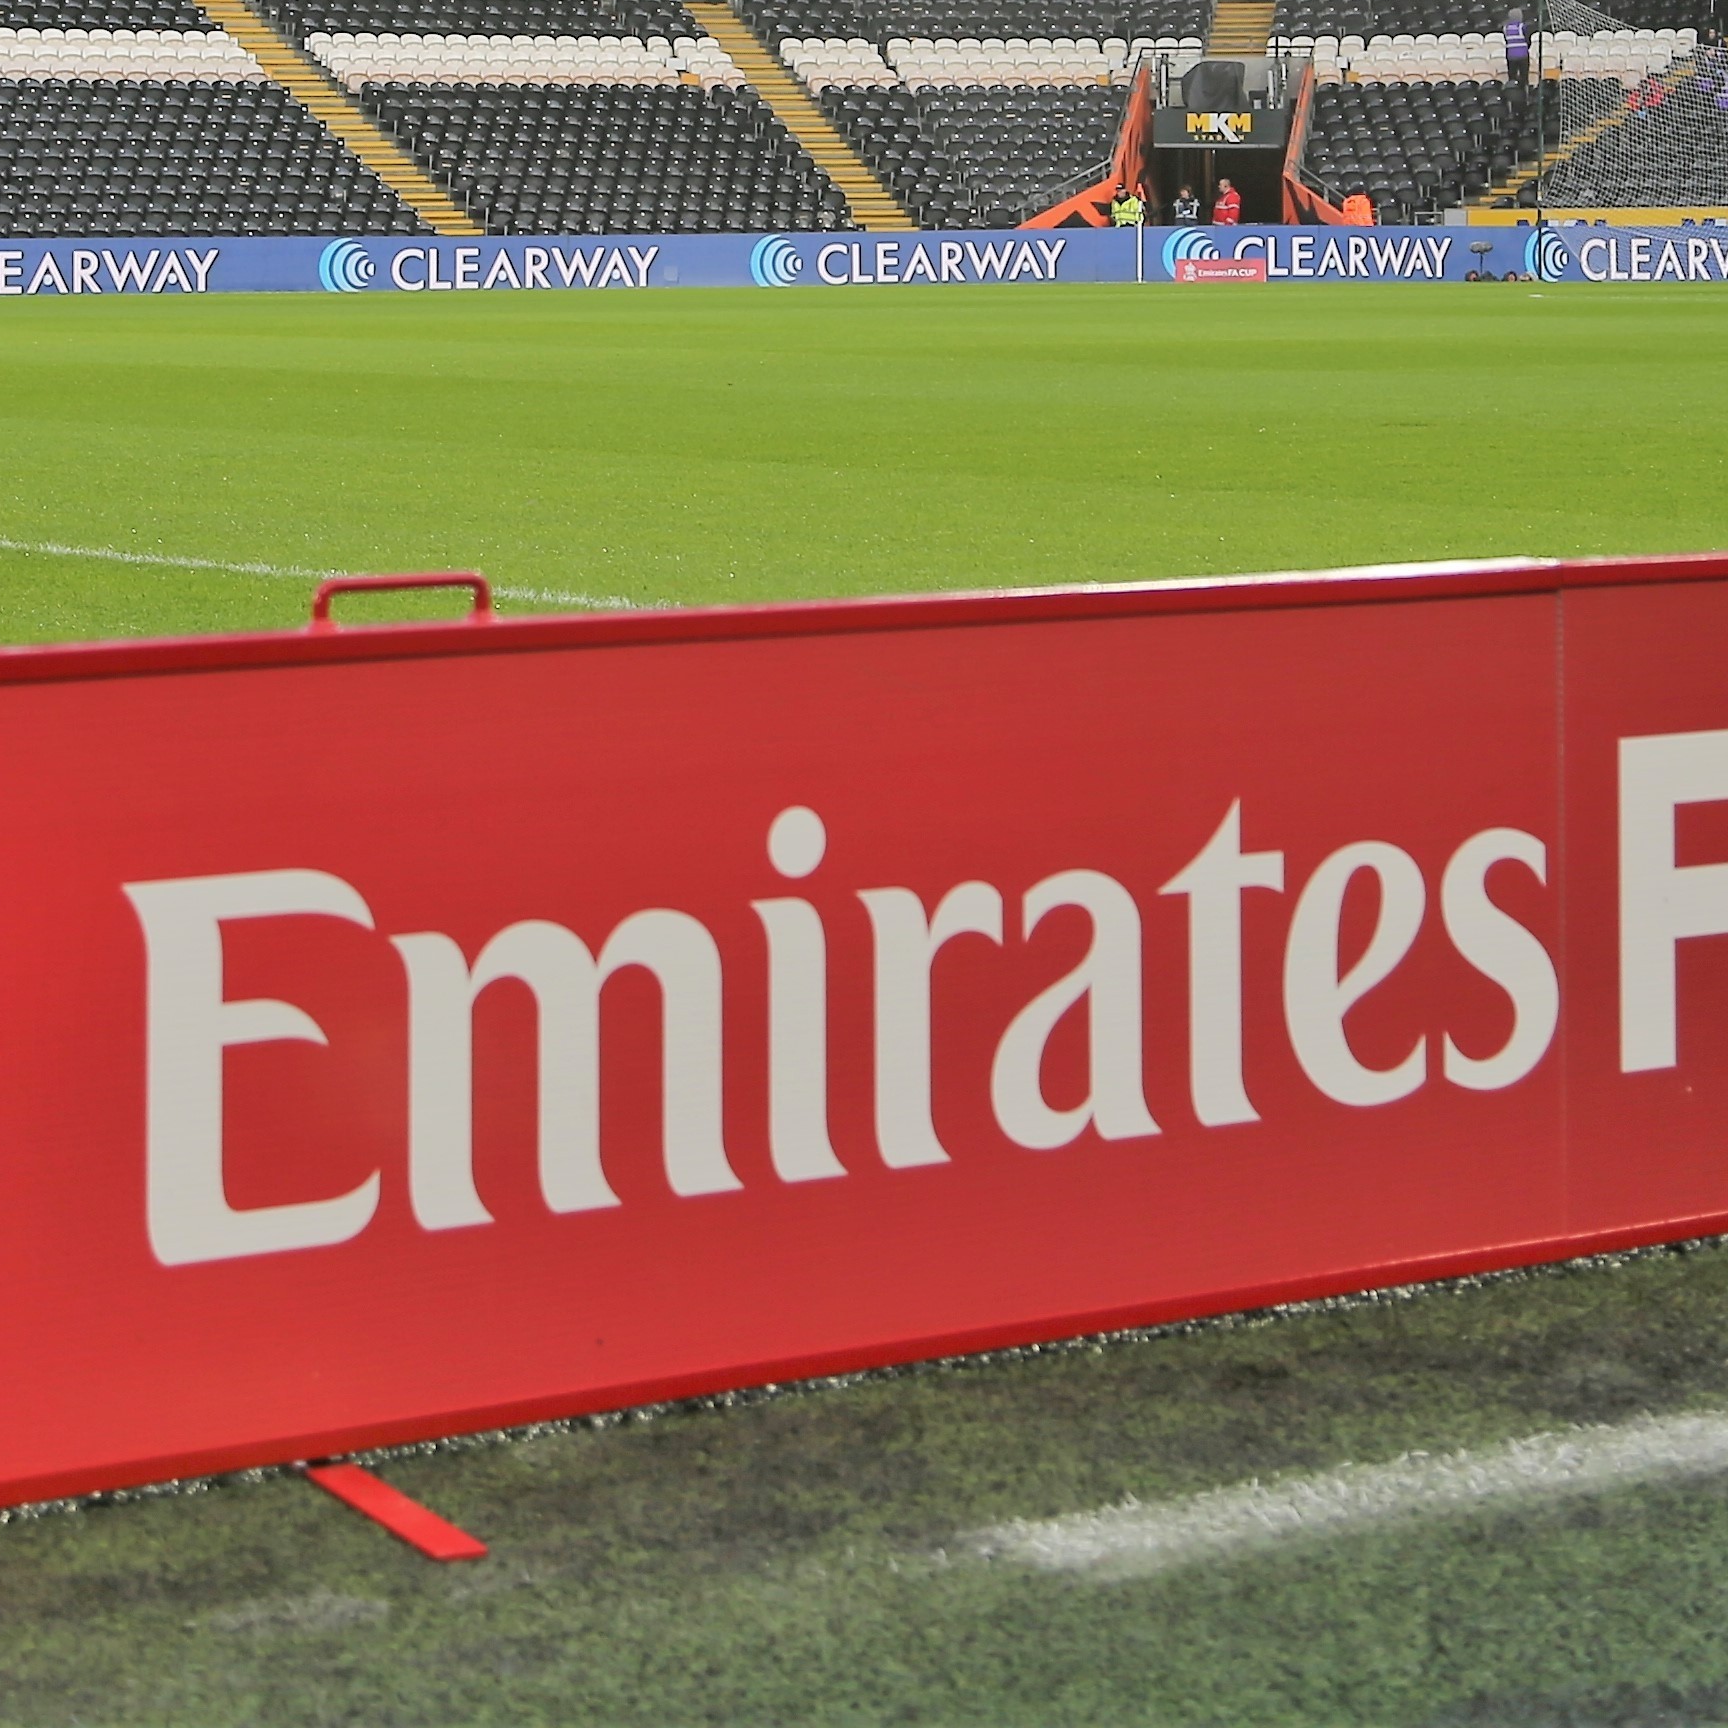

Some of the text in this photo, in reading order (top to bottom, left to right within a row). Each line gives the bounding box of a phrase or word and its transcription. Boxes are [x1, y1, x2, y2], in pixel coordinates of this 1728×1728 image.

[1186, 112, 1251, 143] MKM
[390, 246, 660, 291] CLEARWAY
[816, 238, 1067, 286] CLEARWAY
[1228, 269, 1239, 277] FA
[1239, 268, 1257, 277] CUP
[121, 796, 1560, 1267] Emirates
